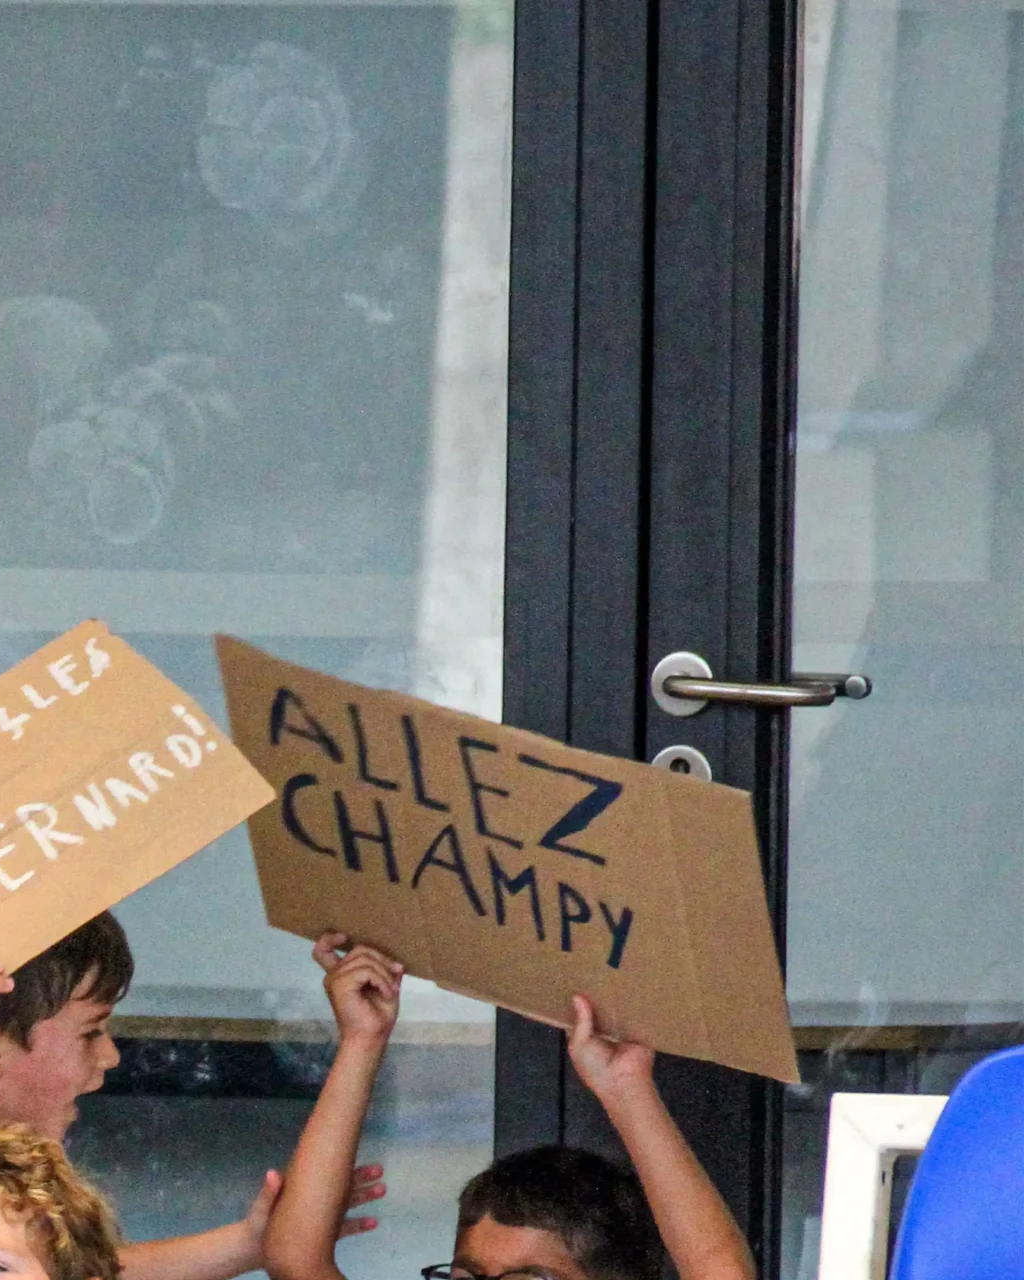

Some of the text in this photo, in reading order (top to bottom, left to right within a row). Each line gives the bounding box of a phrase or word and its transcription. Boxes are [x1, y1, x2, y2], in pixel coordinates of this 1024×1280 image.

[21, 637, 111, 709] LES
[269, 688, 622, 866] ALLEZ
[282, 773, 633, 969] CHAMPY
